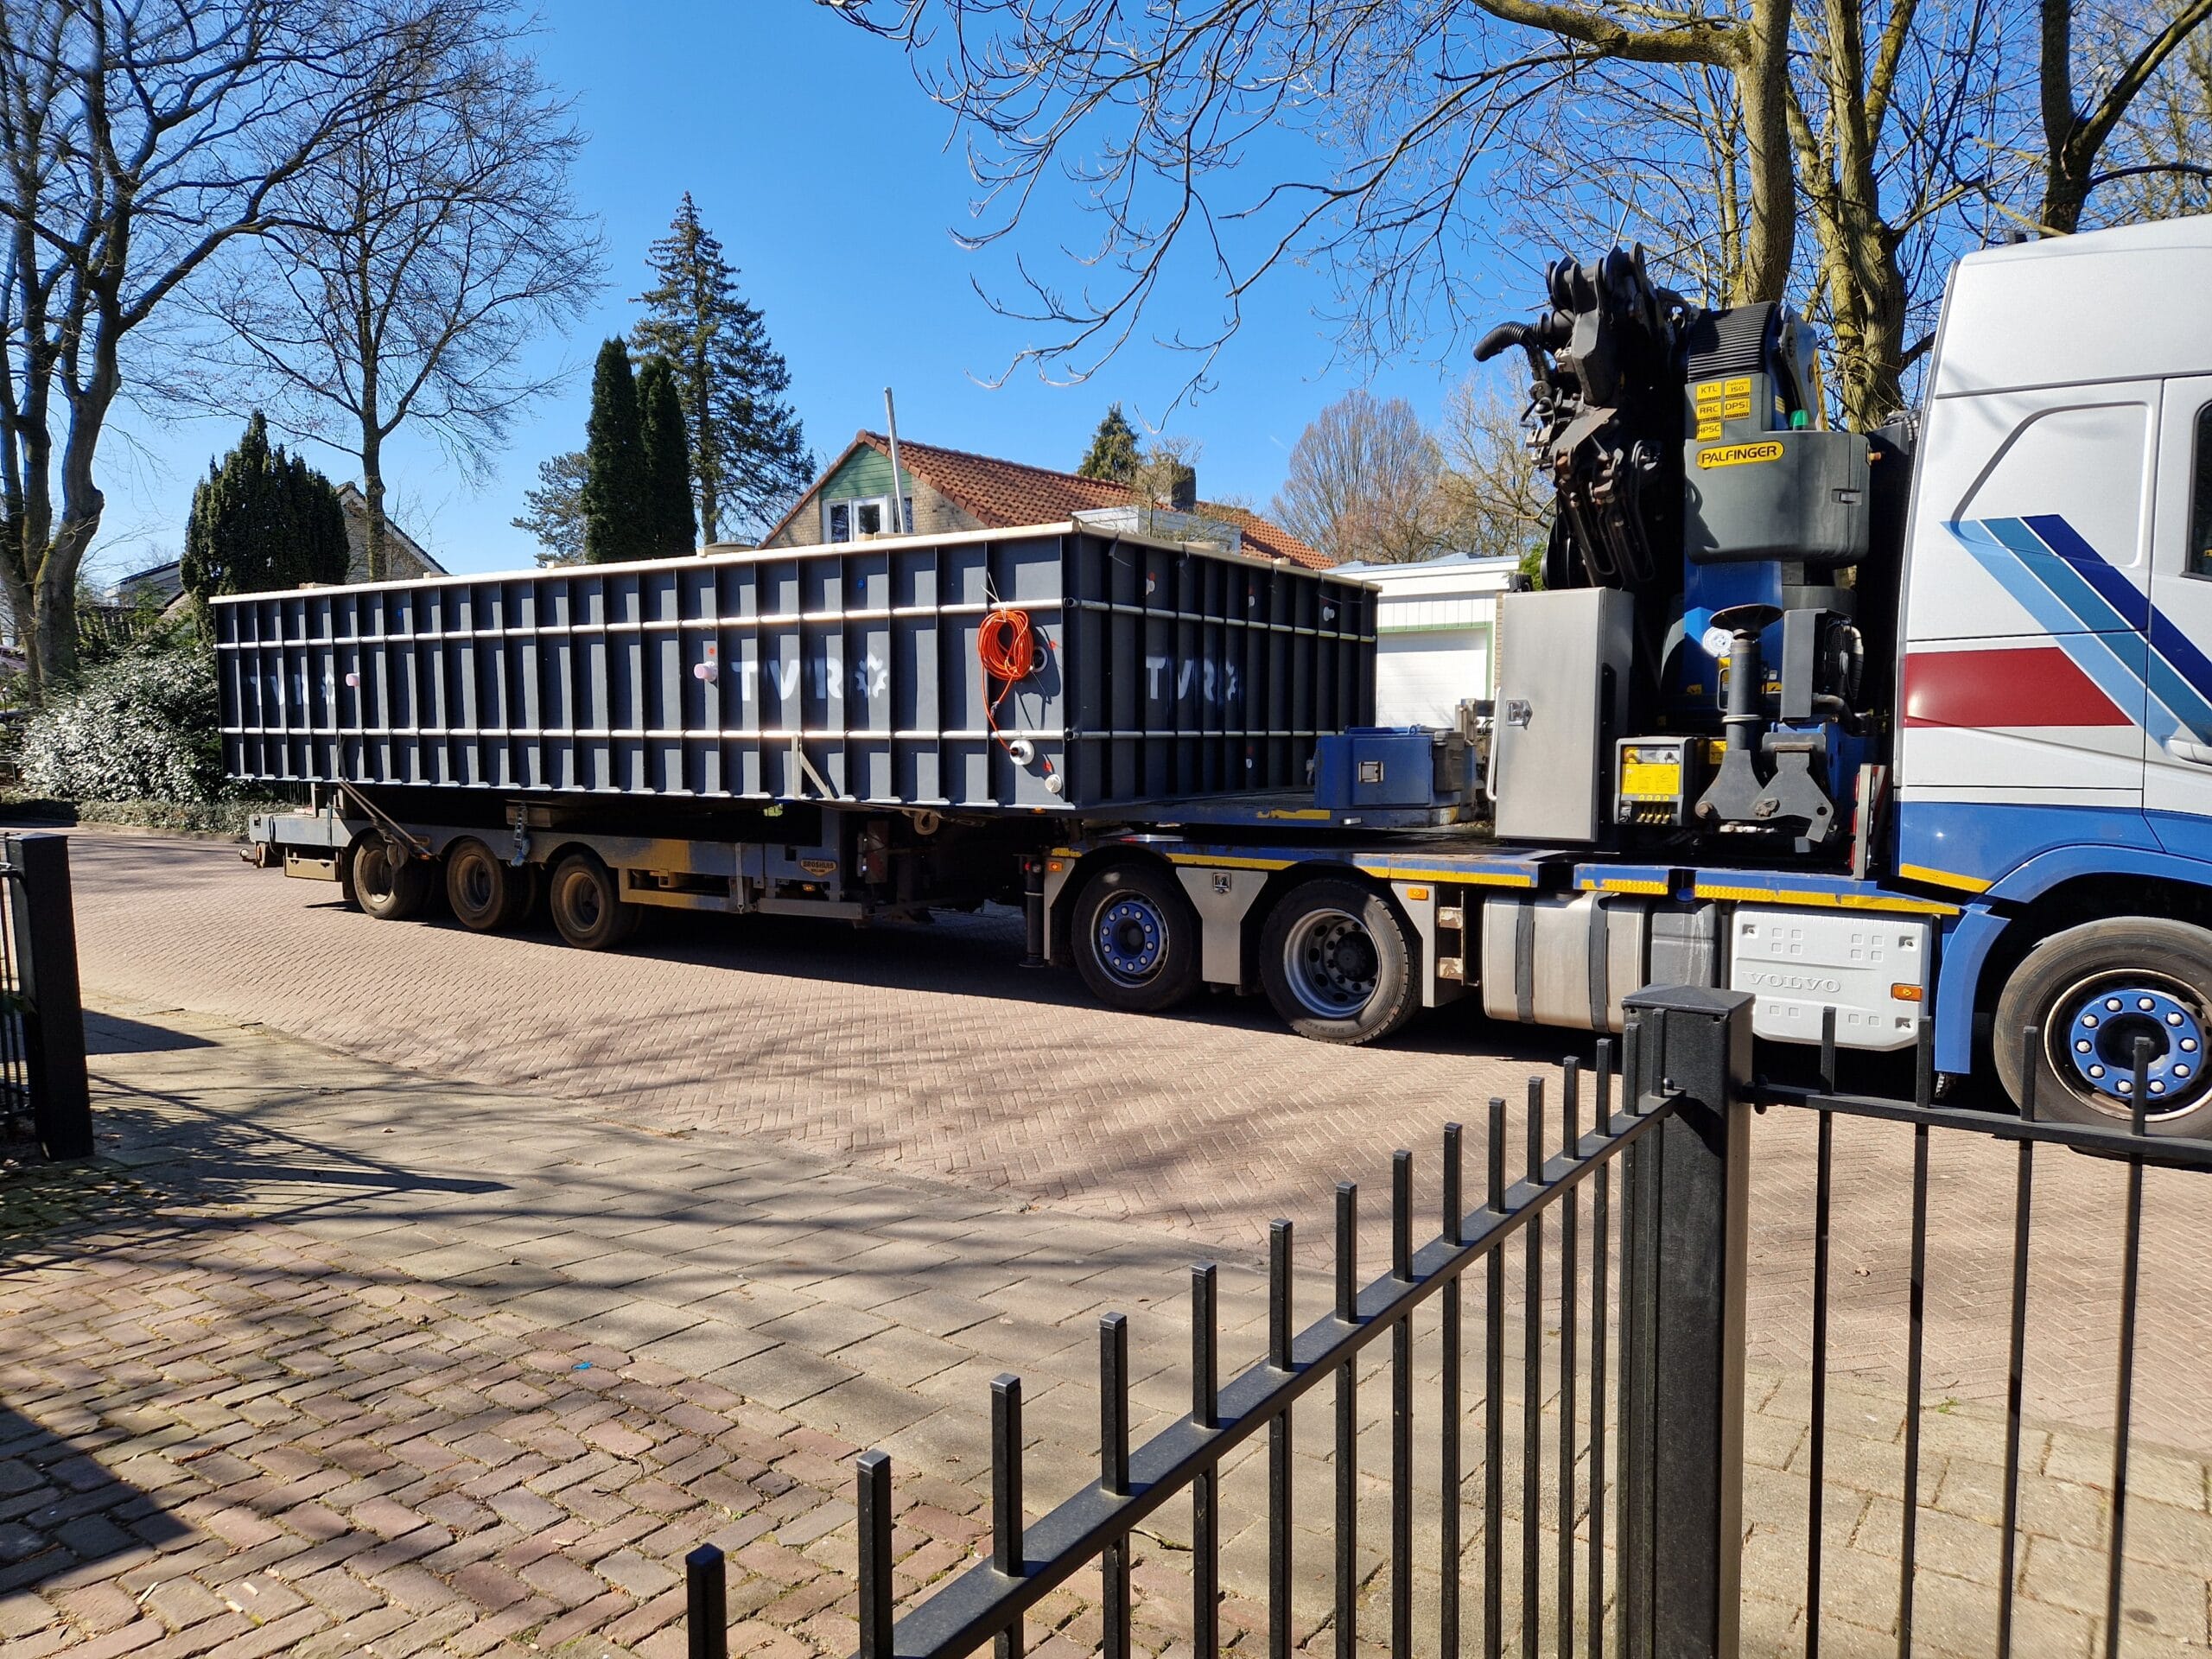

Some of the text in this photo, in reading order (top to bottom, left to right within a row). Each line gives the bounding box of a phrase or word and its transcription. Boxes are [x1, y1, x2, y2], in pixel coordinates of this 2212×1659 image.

[1700, 385, 1718, 394] KTL
[1700, 405, 1719, 414] RRC
[1698, 424, 1719, 434] HPSC
[1701, 446, 1777, 463] PALFINGER
[731, 658, 844, 701] TVR
[1146, 656, 1215, 701] TVR
[1742, 971, 1841, 993] VOLVO
